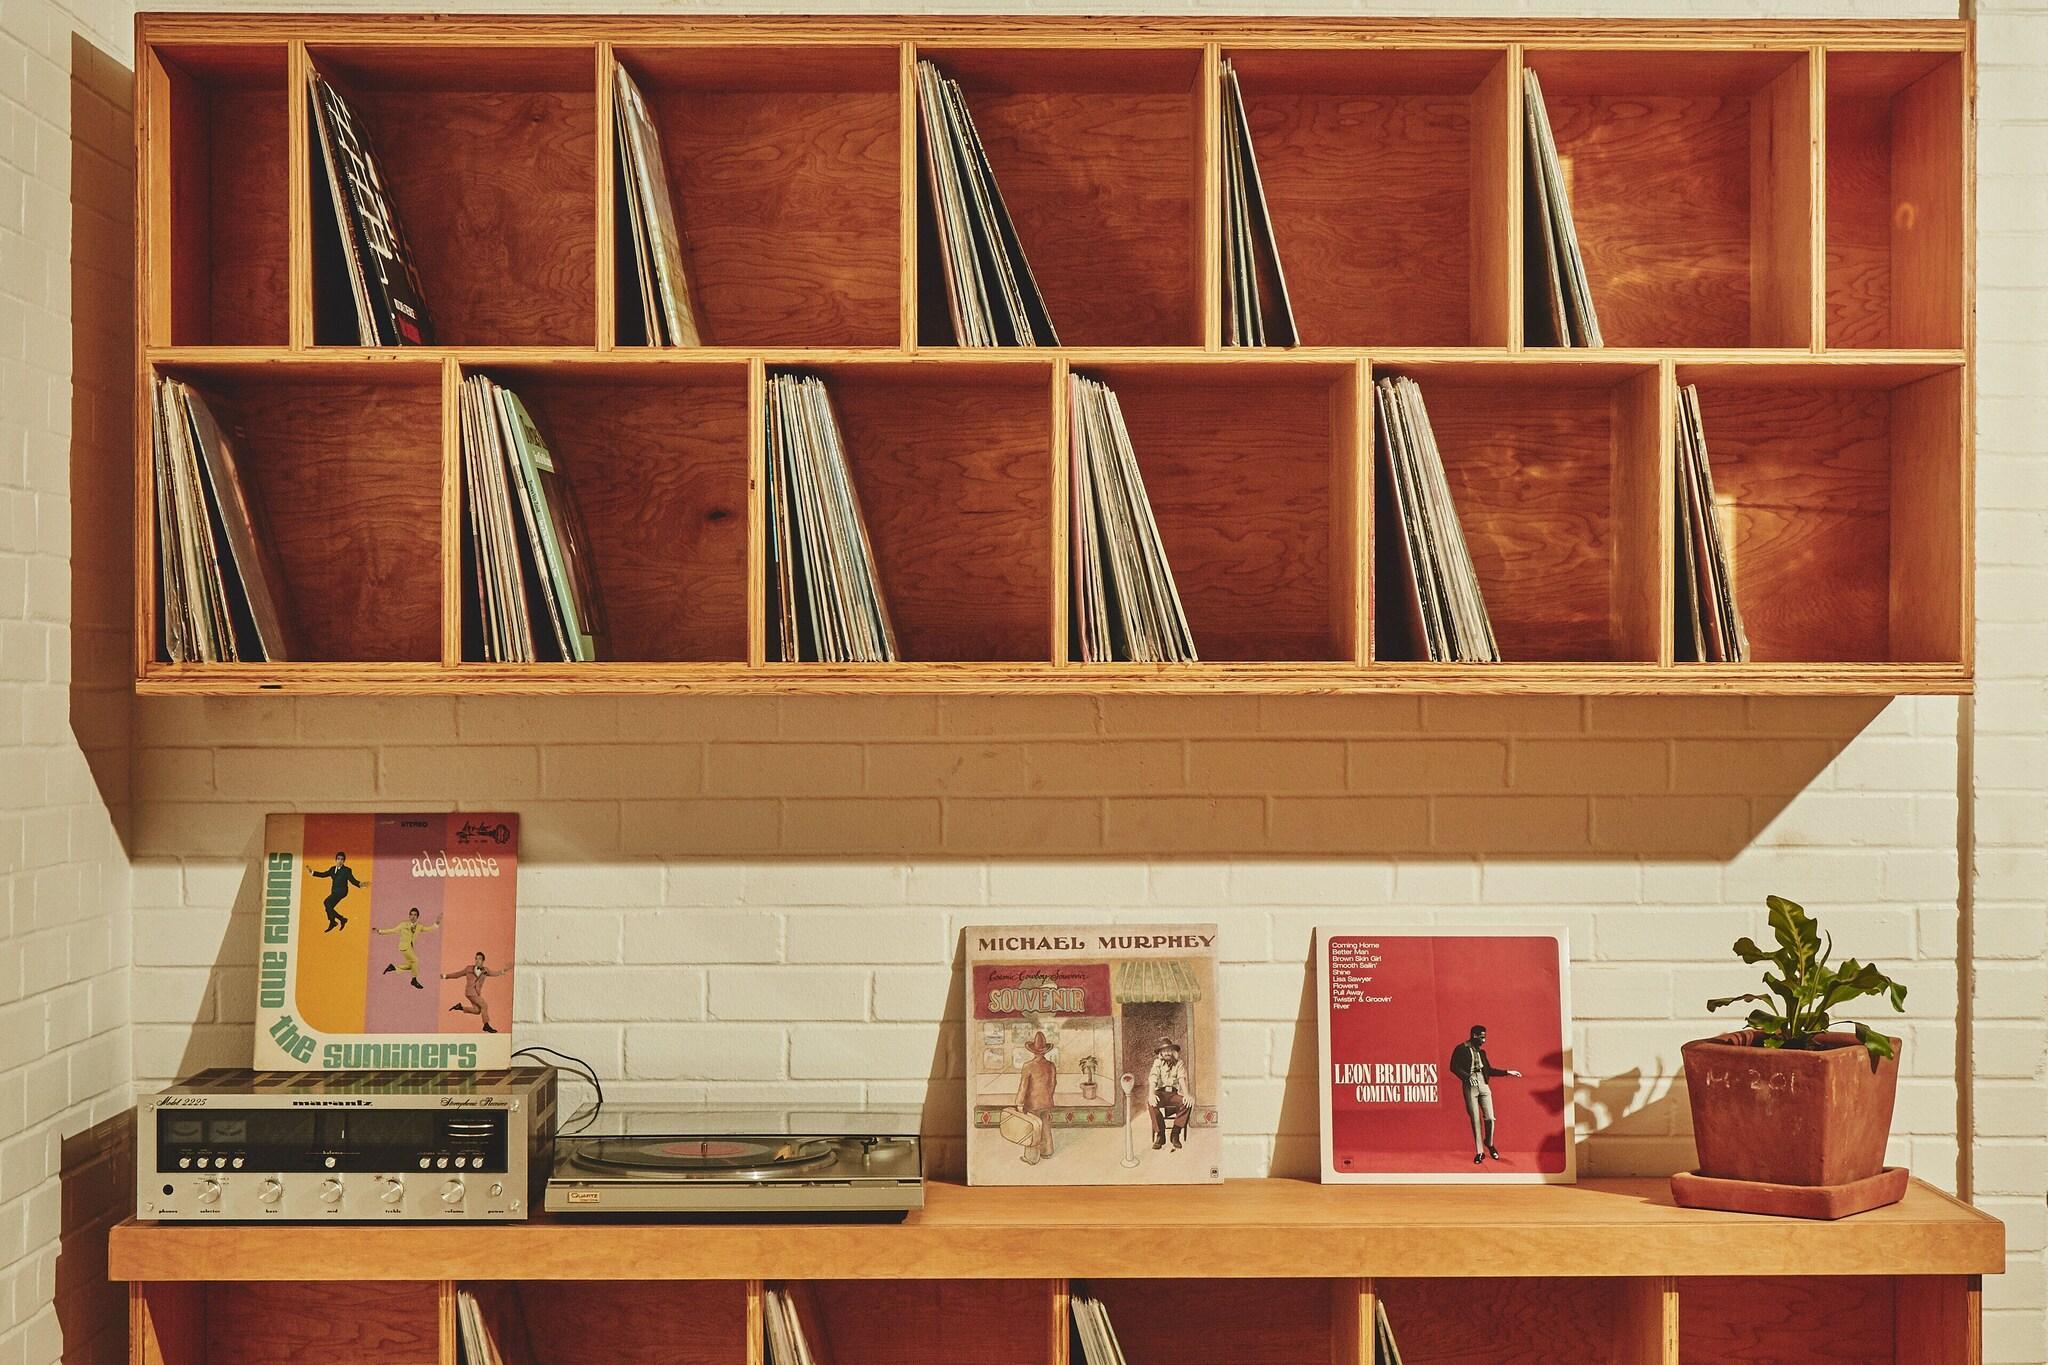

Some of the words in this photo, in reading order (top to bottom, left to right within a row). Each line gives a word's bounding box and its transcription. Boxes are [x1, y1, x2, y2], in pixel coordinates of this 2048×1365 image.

[400, 821, 428, 831] STEREO
[411, 850, 500, 877] adelante
[263, 852, 294, 944] sunny
[978, 936, 1085, 951] MICHAEL
[1098, 935, 1216, 949] MURPHEY
[260, 952, 288, 1008] and
[1347, 976, 1373, 984] Sawyer
[988, 988, 1085, 1013] SOUVENIR
[1345, 989, 1365, 997] Away
[269, 1014, 317, 1064] the
[323, 1043, 477, 1069] sunliners
[1334, 1063, 1372, 1084] LEON
[1375, 1063, 1438, 1084] BRIDGES
[156, 1096, 183, 1107] Model
[293, 1099, 373, 1107] marantz
[1356, 1085, 1401, 1102] COMING
[1403, 1085, 1438, 1102] HOME
